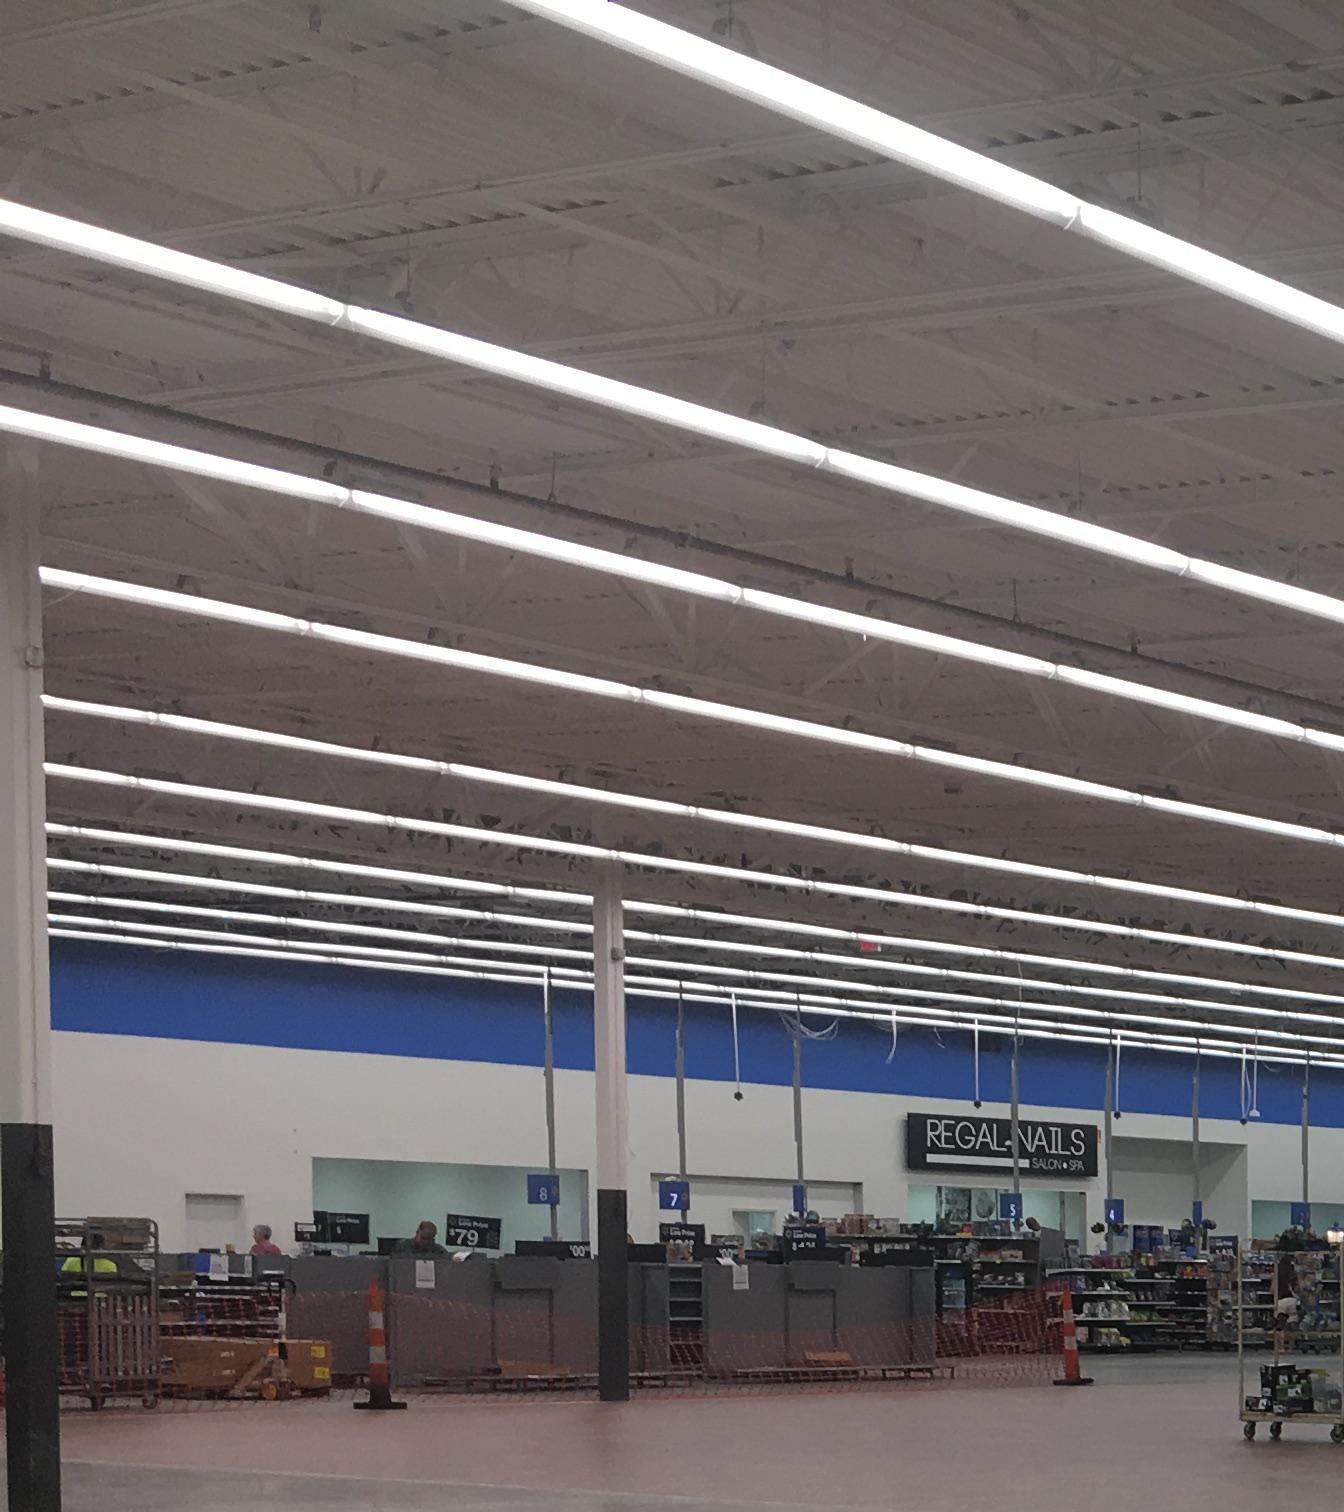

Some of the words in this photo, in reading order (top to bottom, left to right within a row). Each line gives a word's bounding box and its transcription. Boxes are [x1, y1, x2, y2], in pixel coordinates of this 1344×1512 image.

[926, 1119, 1007, 1152] REGAL
[1017, 1125, 1085, 1156] NAILS
[1031, 1158, 1063, 1170] SALON
[1069, 1159, 1086, 1171] SPA
[539, 1187, 548, 1200] 8
[669, 1193, 678, 1207] 7
[1009, 1203, 1017, 1216] 5
[1109, 1209, 1115, 1221] 4
